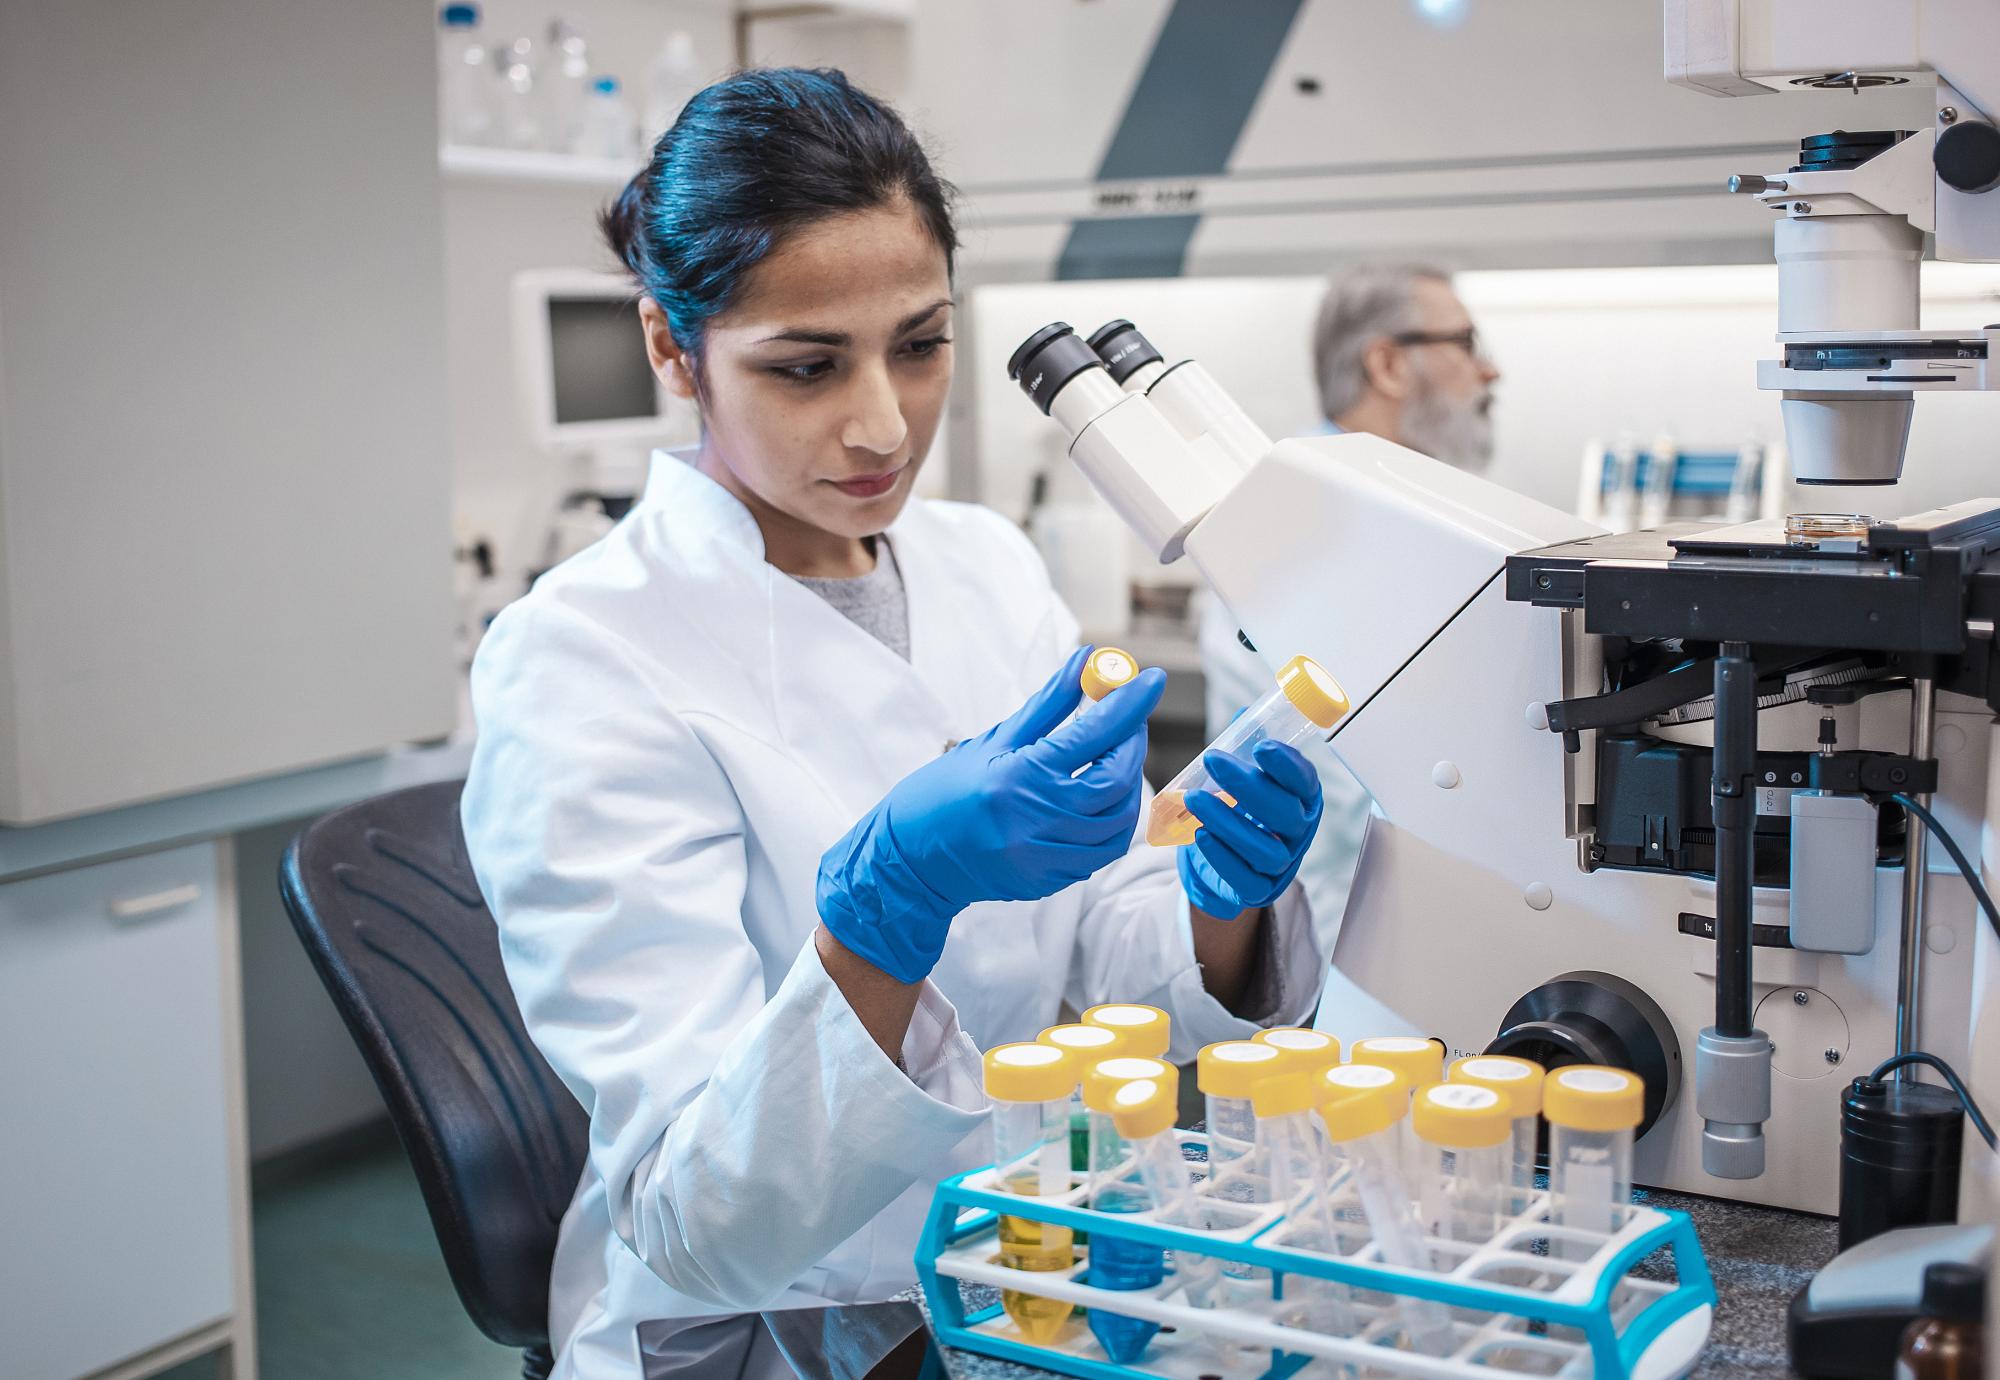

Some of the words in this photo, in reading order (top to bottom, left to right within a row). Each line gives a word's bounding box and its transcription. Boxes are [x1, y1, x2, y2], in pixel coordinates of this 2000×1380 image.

[1816, 350, 1826, 360] Ph
[1704, 922, 1713, 932] 1x
[1454, 1049, 1463, 1058] FL
